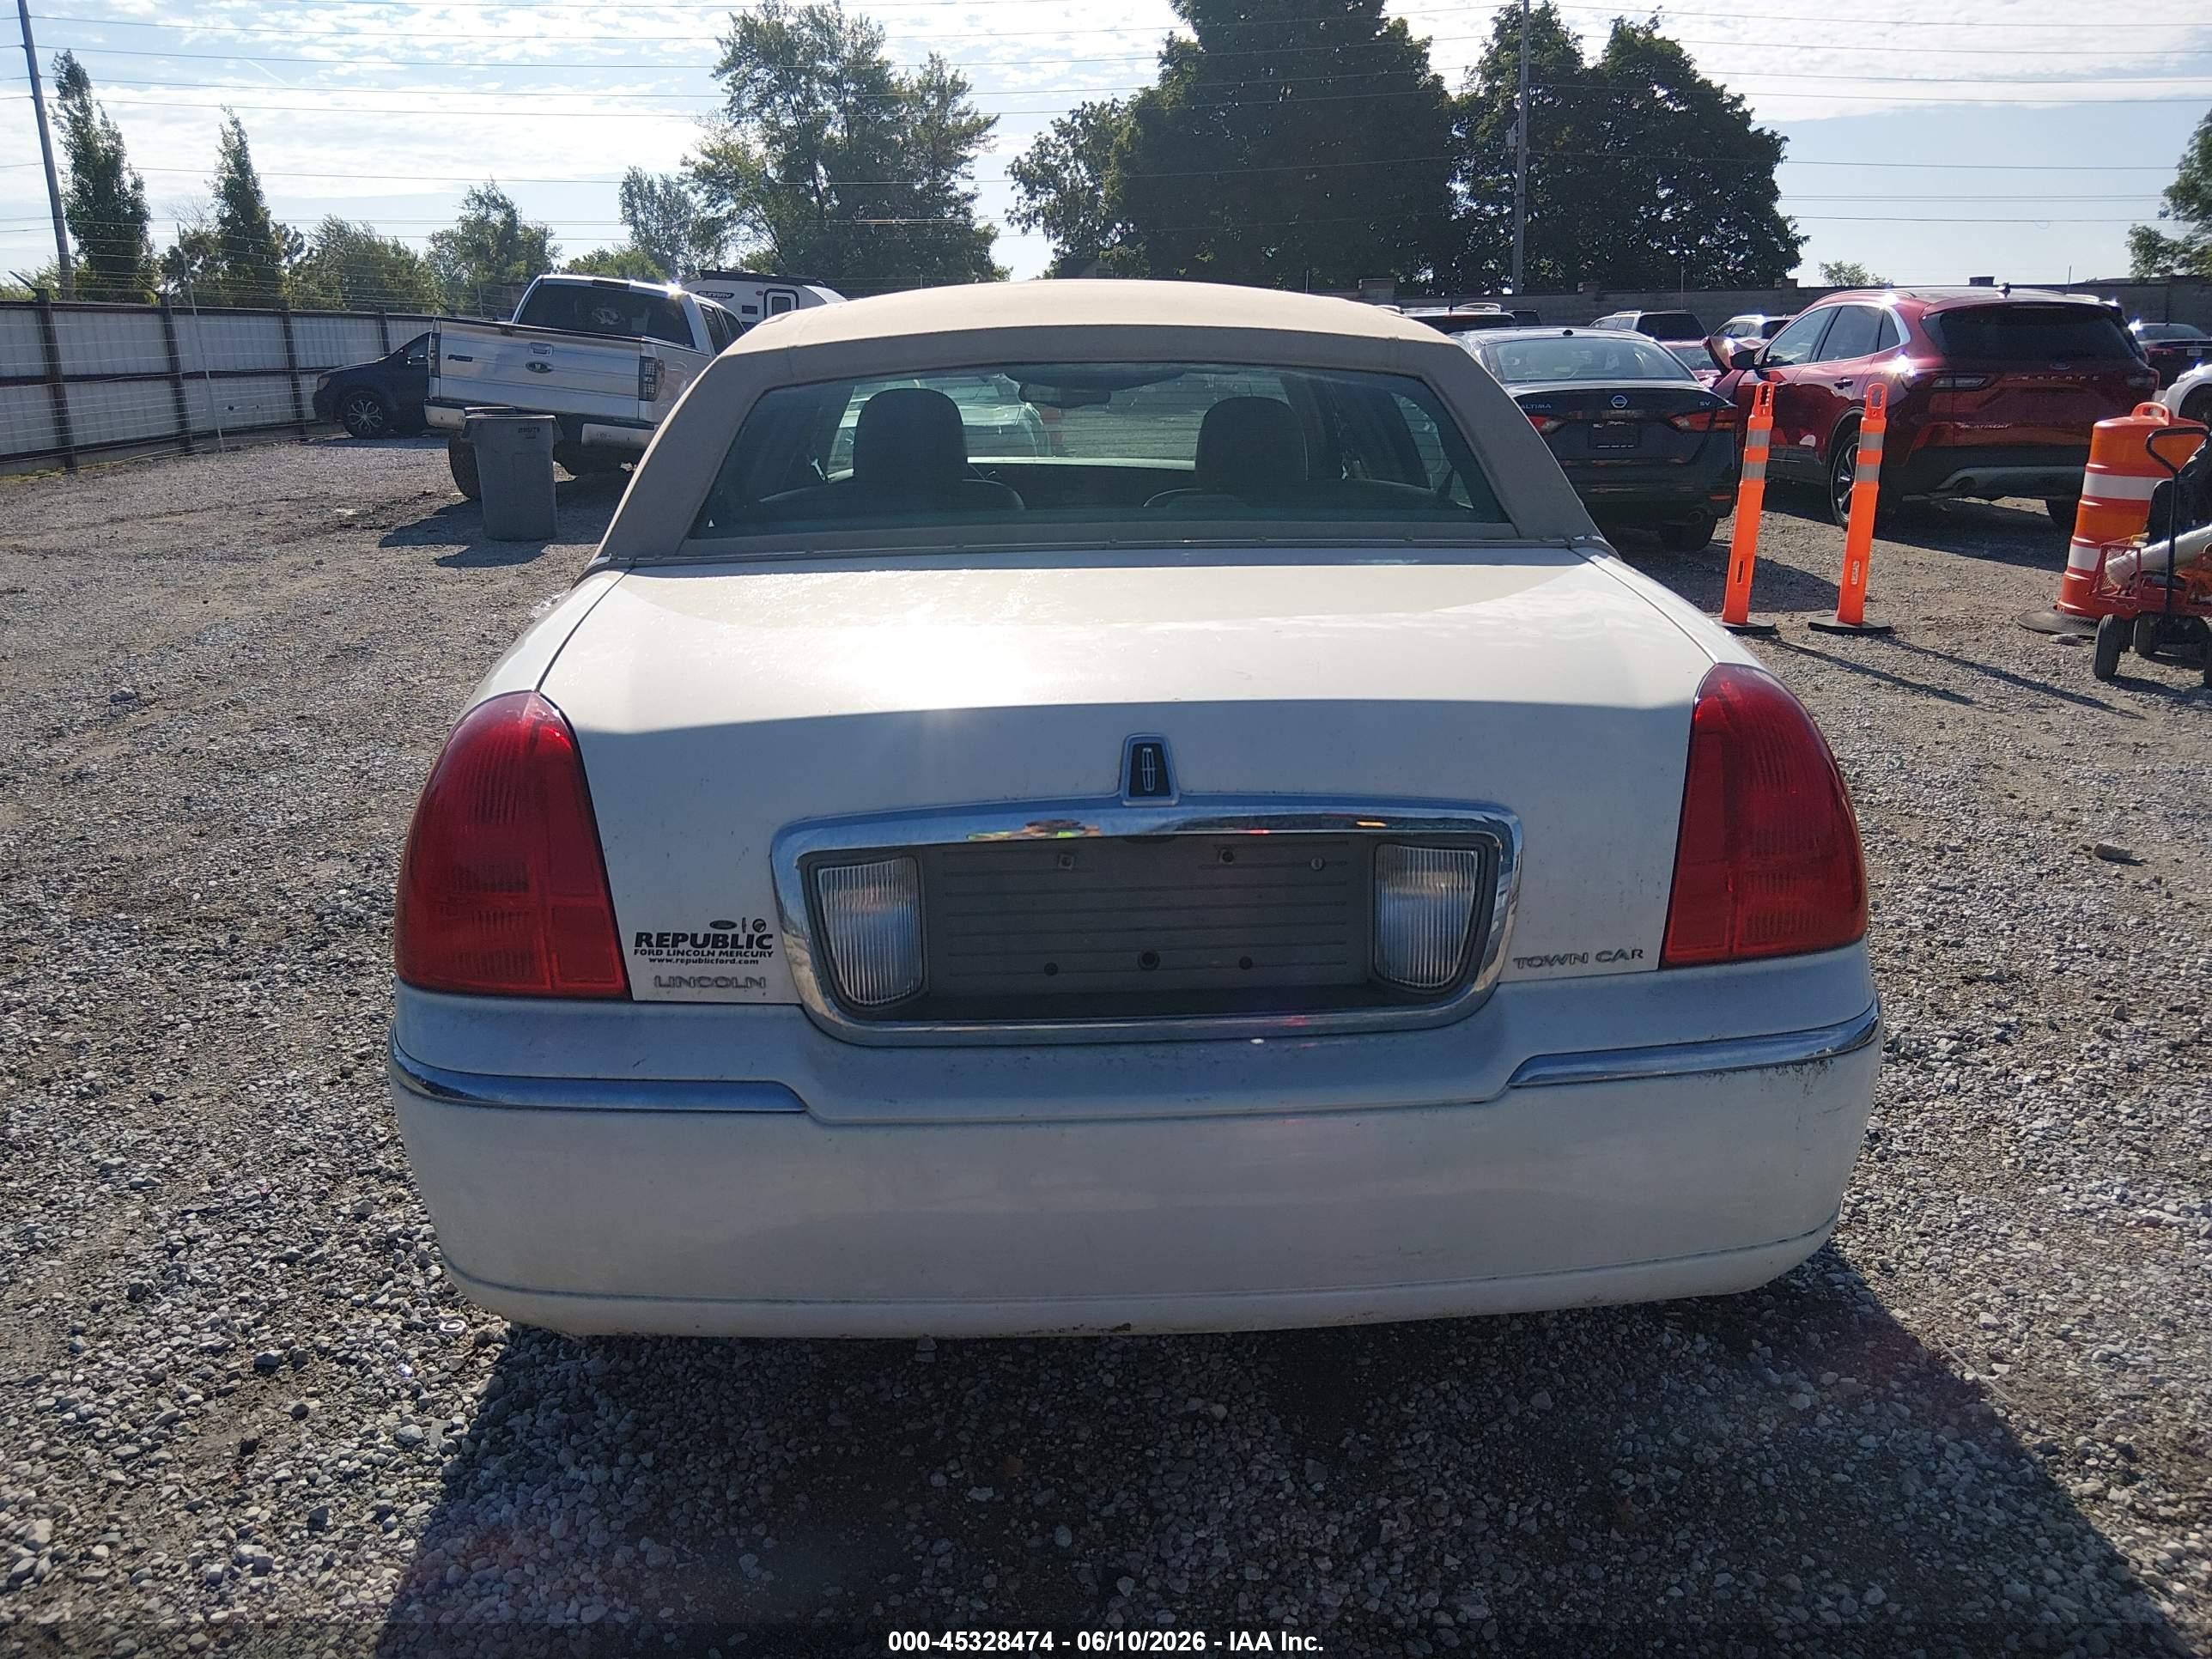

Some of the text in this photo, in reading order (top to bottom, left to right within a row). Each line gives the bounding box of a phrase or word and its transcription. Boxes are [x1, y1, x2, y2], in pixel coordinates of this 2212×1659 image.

[635, 932, 774, 950] REPUBLIC
[648, 957, 759, 965] www.republicford.com
[1513, 948, 1644, 969] TOWN CAR
[654, 975, 766, 988] LINCOLN
